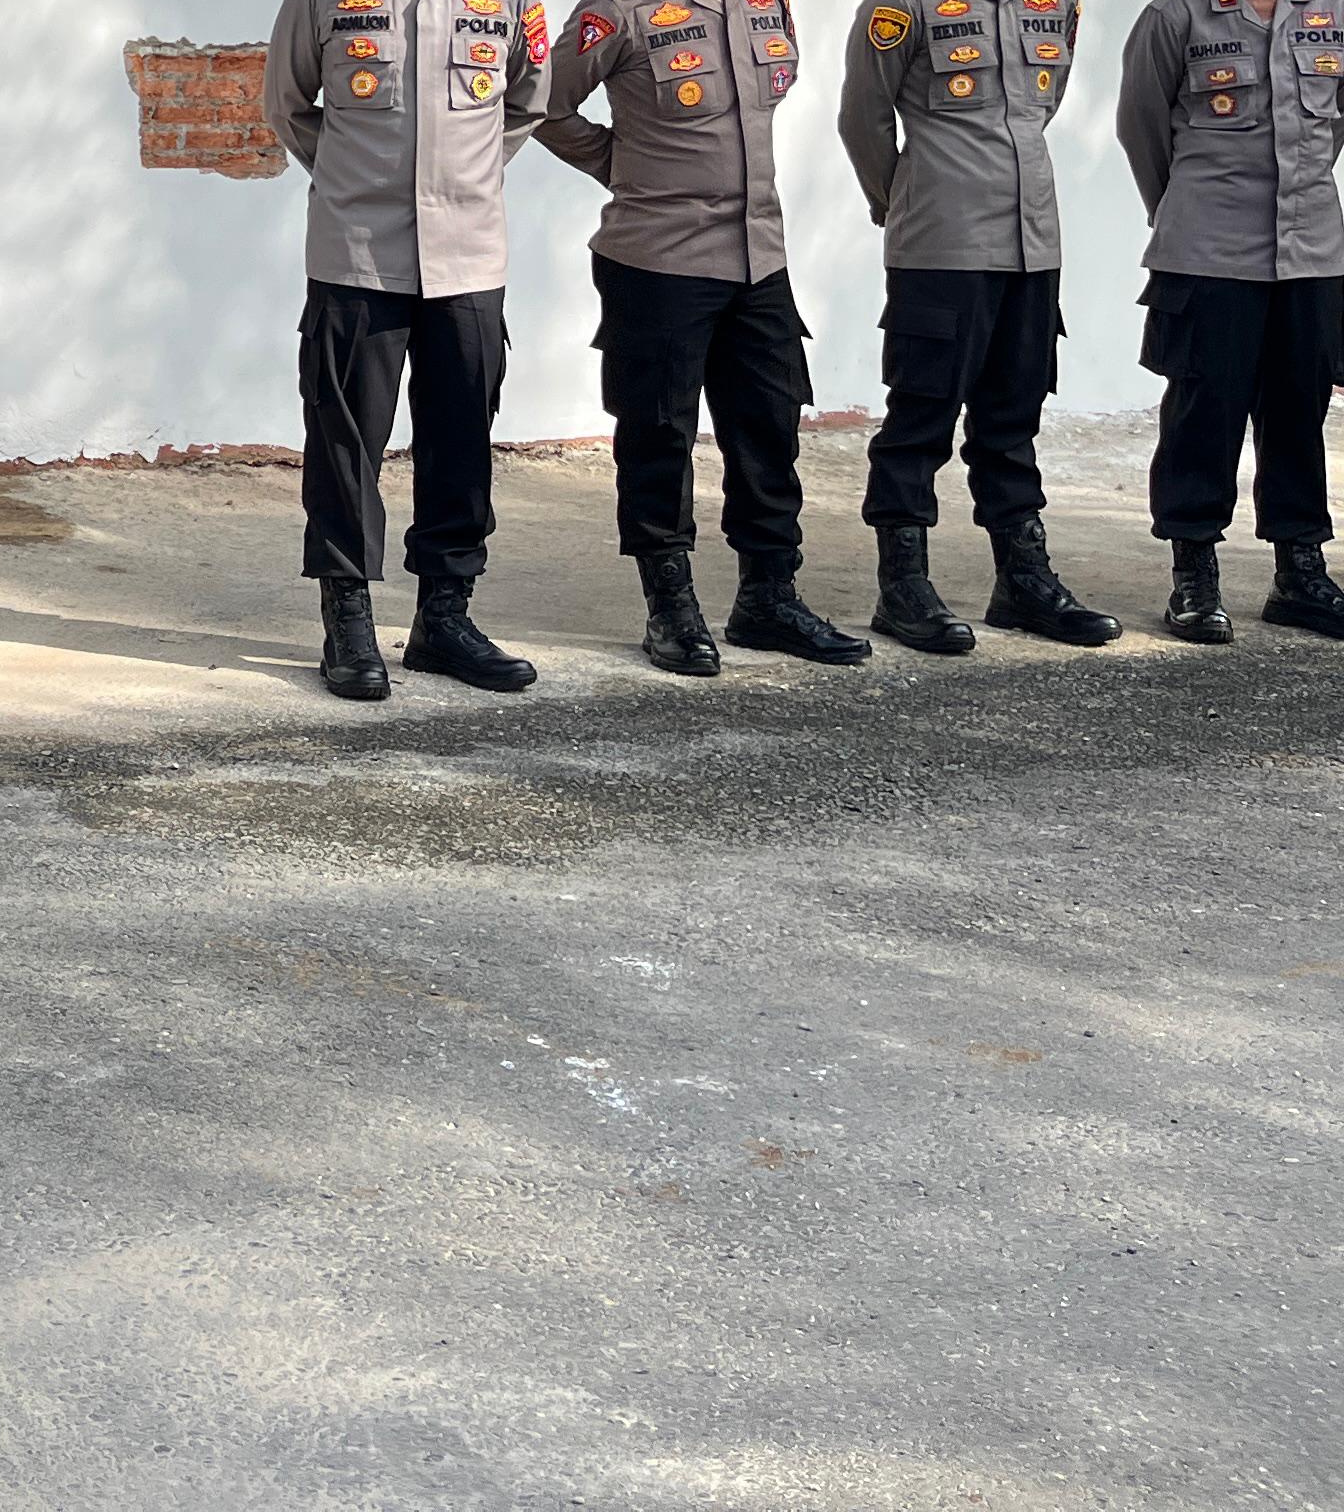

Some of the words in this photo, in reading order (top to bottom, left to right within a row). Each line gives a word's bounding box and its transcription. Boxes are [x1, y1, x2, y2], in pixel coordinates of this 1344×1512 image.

[455, 18, 508, 37] POLRI
[751, 17, 781, 31] POLRI
[932, 21, 984, 40] HENDRI
[1023, 19, 1064, 34] POLRI
[1295, 30, 1344, 43] POLRI
[1190, 42, 1242, 57] SUHARDI
